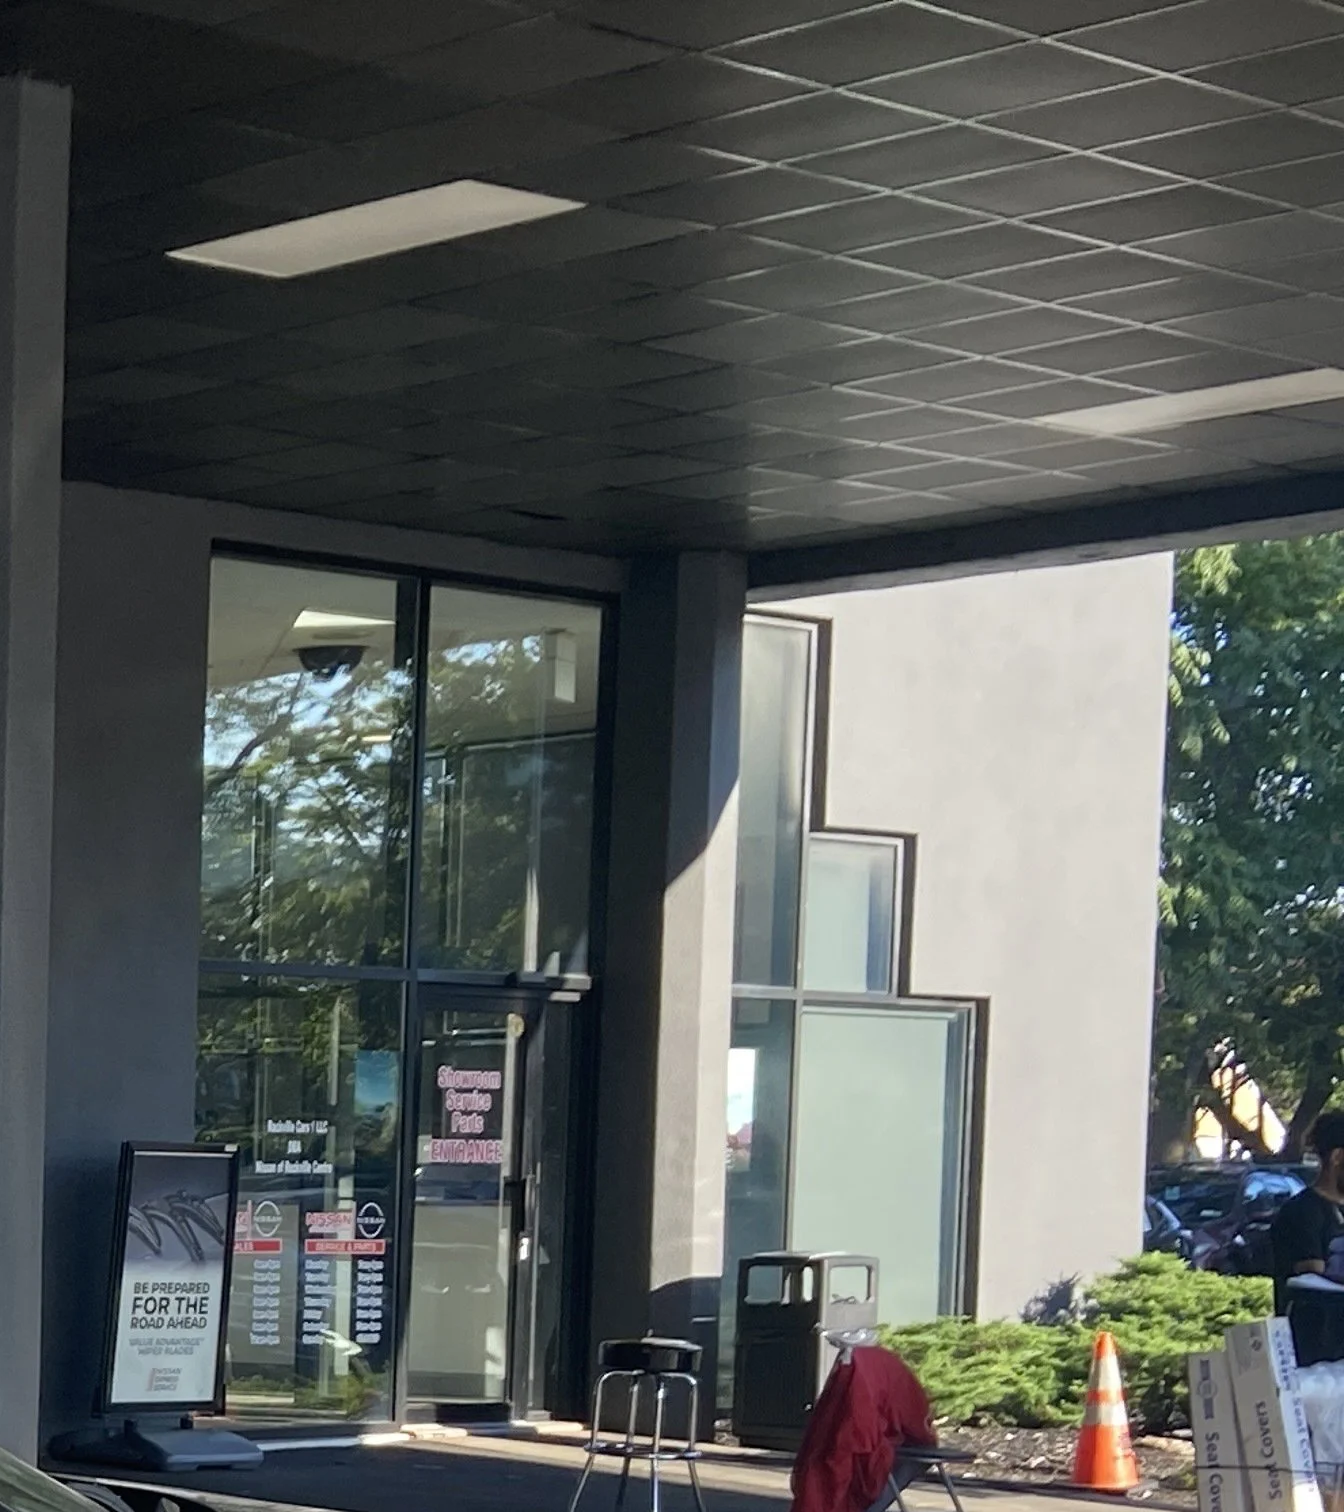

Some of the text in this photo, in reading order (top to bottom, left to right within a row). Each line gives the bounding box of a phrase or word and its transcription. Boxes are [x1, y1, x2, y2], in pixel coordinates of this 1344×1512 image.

[438, 1065, 501, 1089] Showroom
[446, 1088, 492, 1111] Service
[451, 1111, 484, 1133] Parts
[430, 1139, 502, 1163] ENTRANCE
[305, 1212, 351, 1225] NISSAN
[234, 1242, 254, 1250] ALES
[134, 1282, 210, 1294] BE PREPARED
[132, 1297, 210, 1315] FOR THE
[130, 1317, 207, 1329] ROAD AHEAD
[1254, 1401, 1276, 1458] Covers
[1205, 1432, 1221, 1468] Seat
